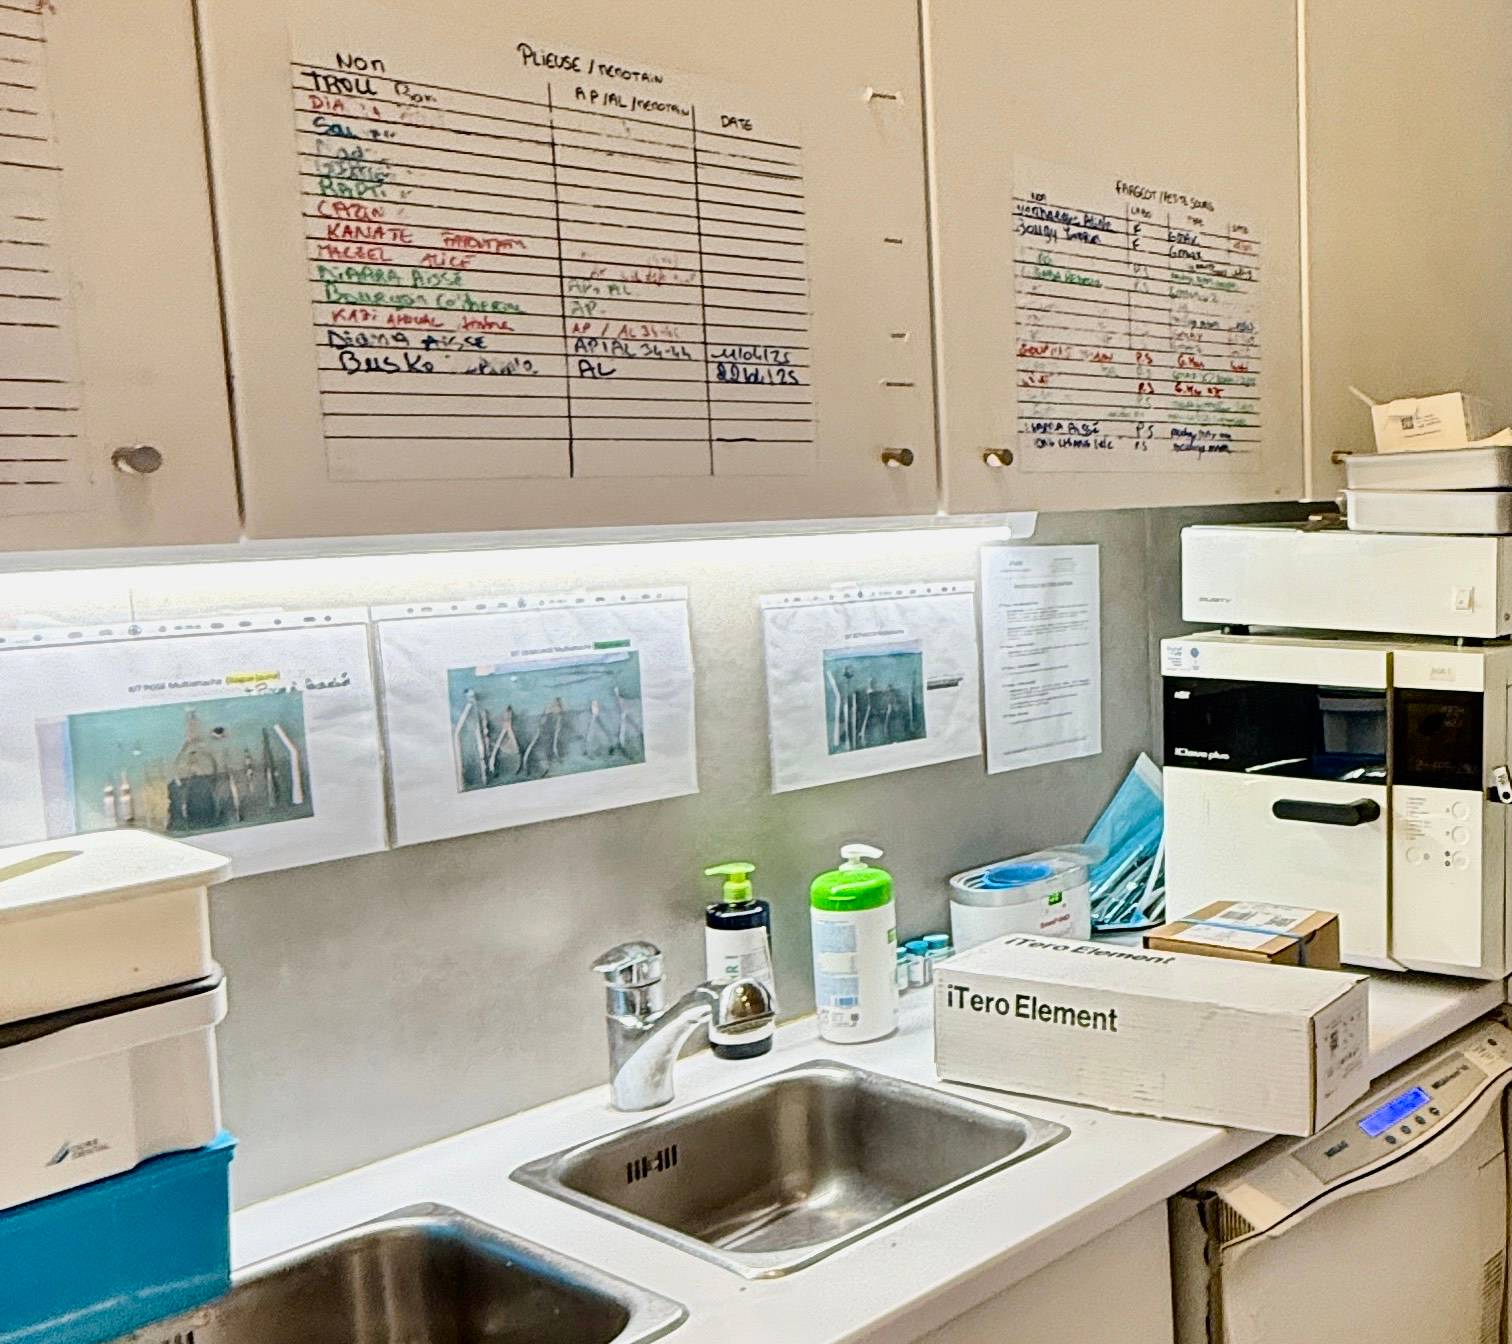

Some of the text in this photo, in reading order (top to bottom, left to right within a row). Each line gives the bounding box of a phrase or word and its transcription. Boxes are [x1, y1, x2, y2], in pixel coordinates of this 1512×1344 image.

[1004, 937, 1176, 964] iTero Element
[946, 983, 1119, 1033] iTero Element
